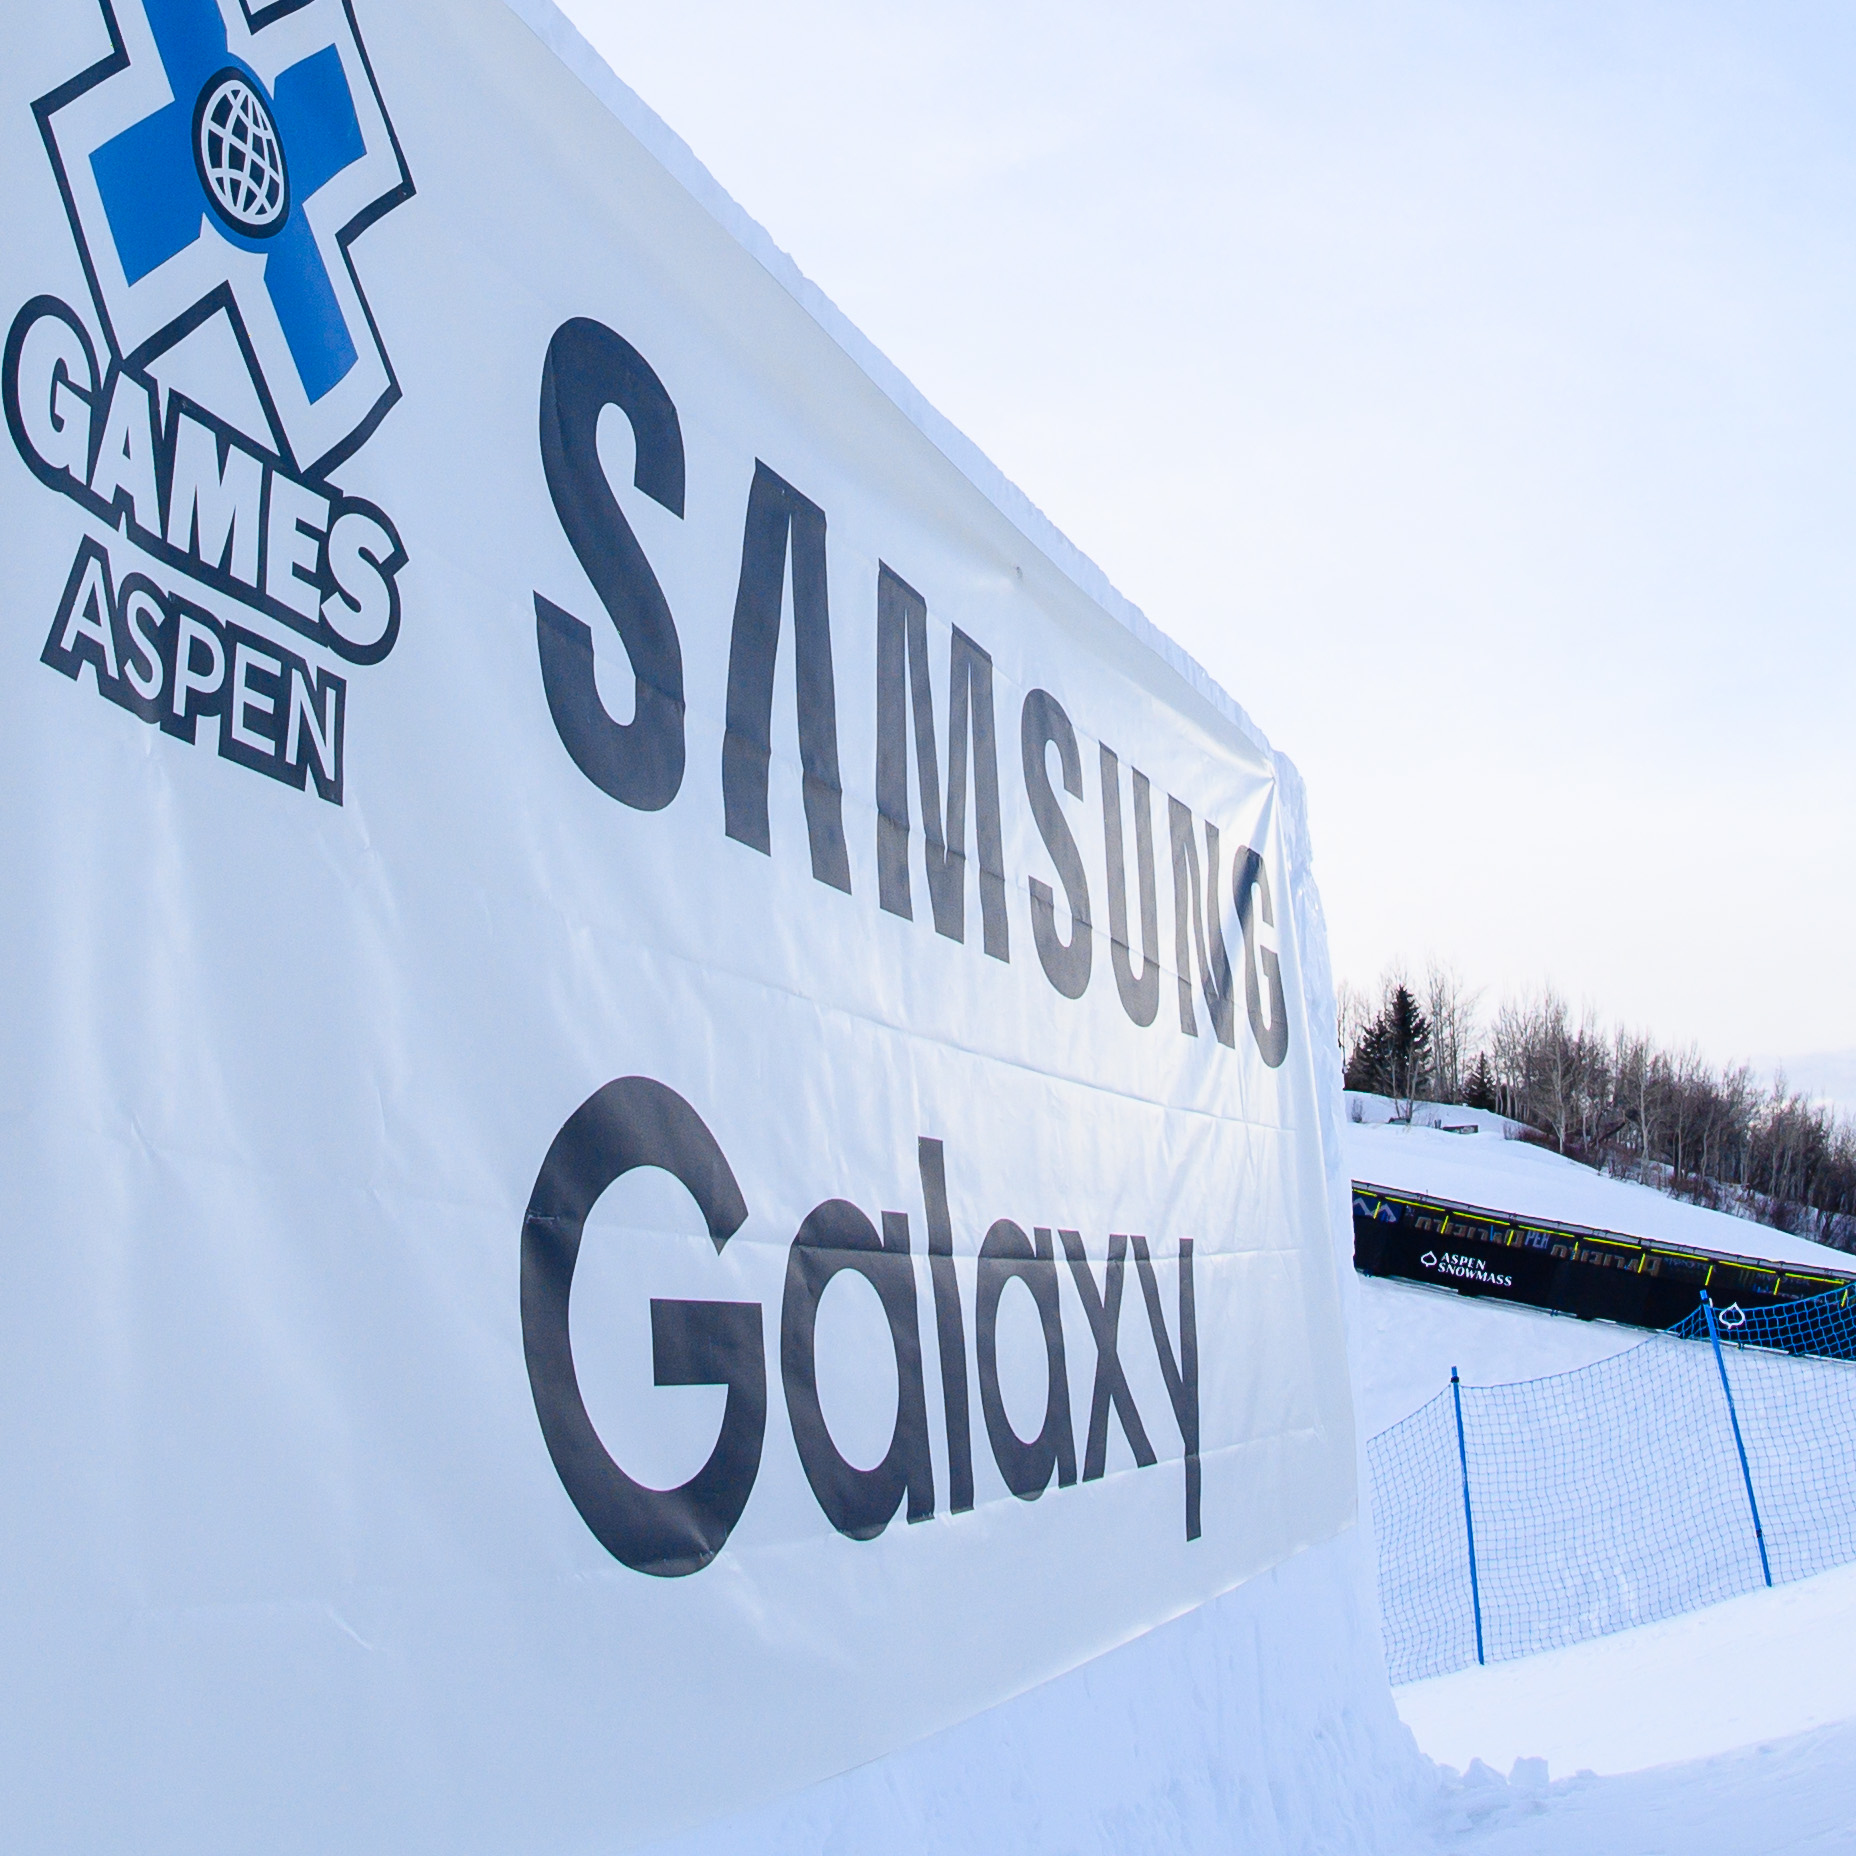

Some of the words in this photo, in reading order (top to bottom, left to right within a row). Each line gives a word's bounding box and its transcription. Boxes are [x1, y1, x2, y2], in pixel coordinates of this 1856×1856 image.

[3, 294, 409, 665] GAMES
[41, 534, 346, 806] ASPEN
[534, 316, 1287, 1069] SAMSUNG
[520, 1075, 1202, 1578] Galaxy
[1437, 1262, 1512, 1287] SNOWMASS
[1441, 1252, 1486, 1270] ASPEN
